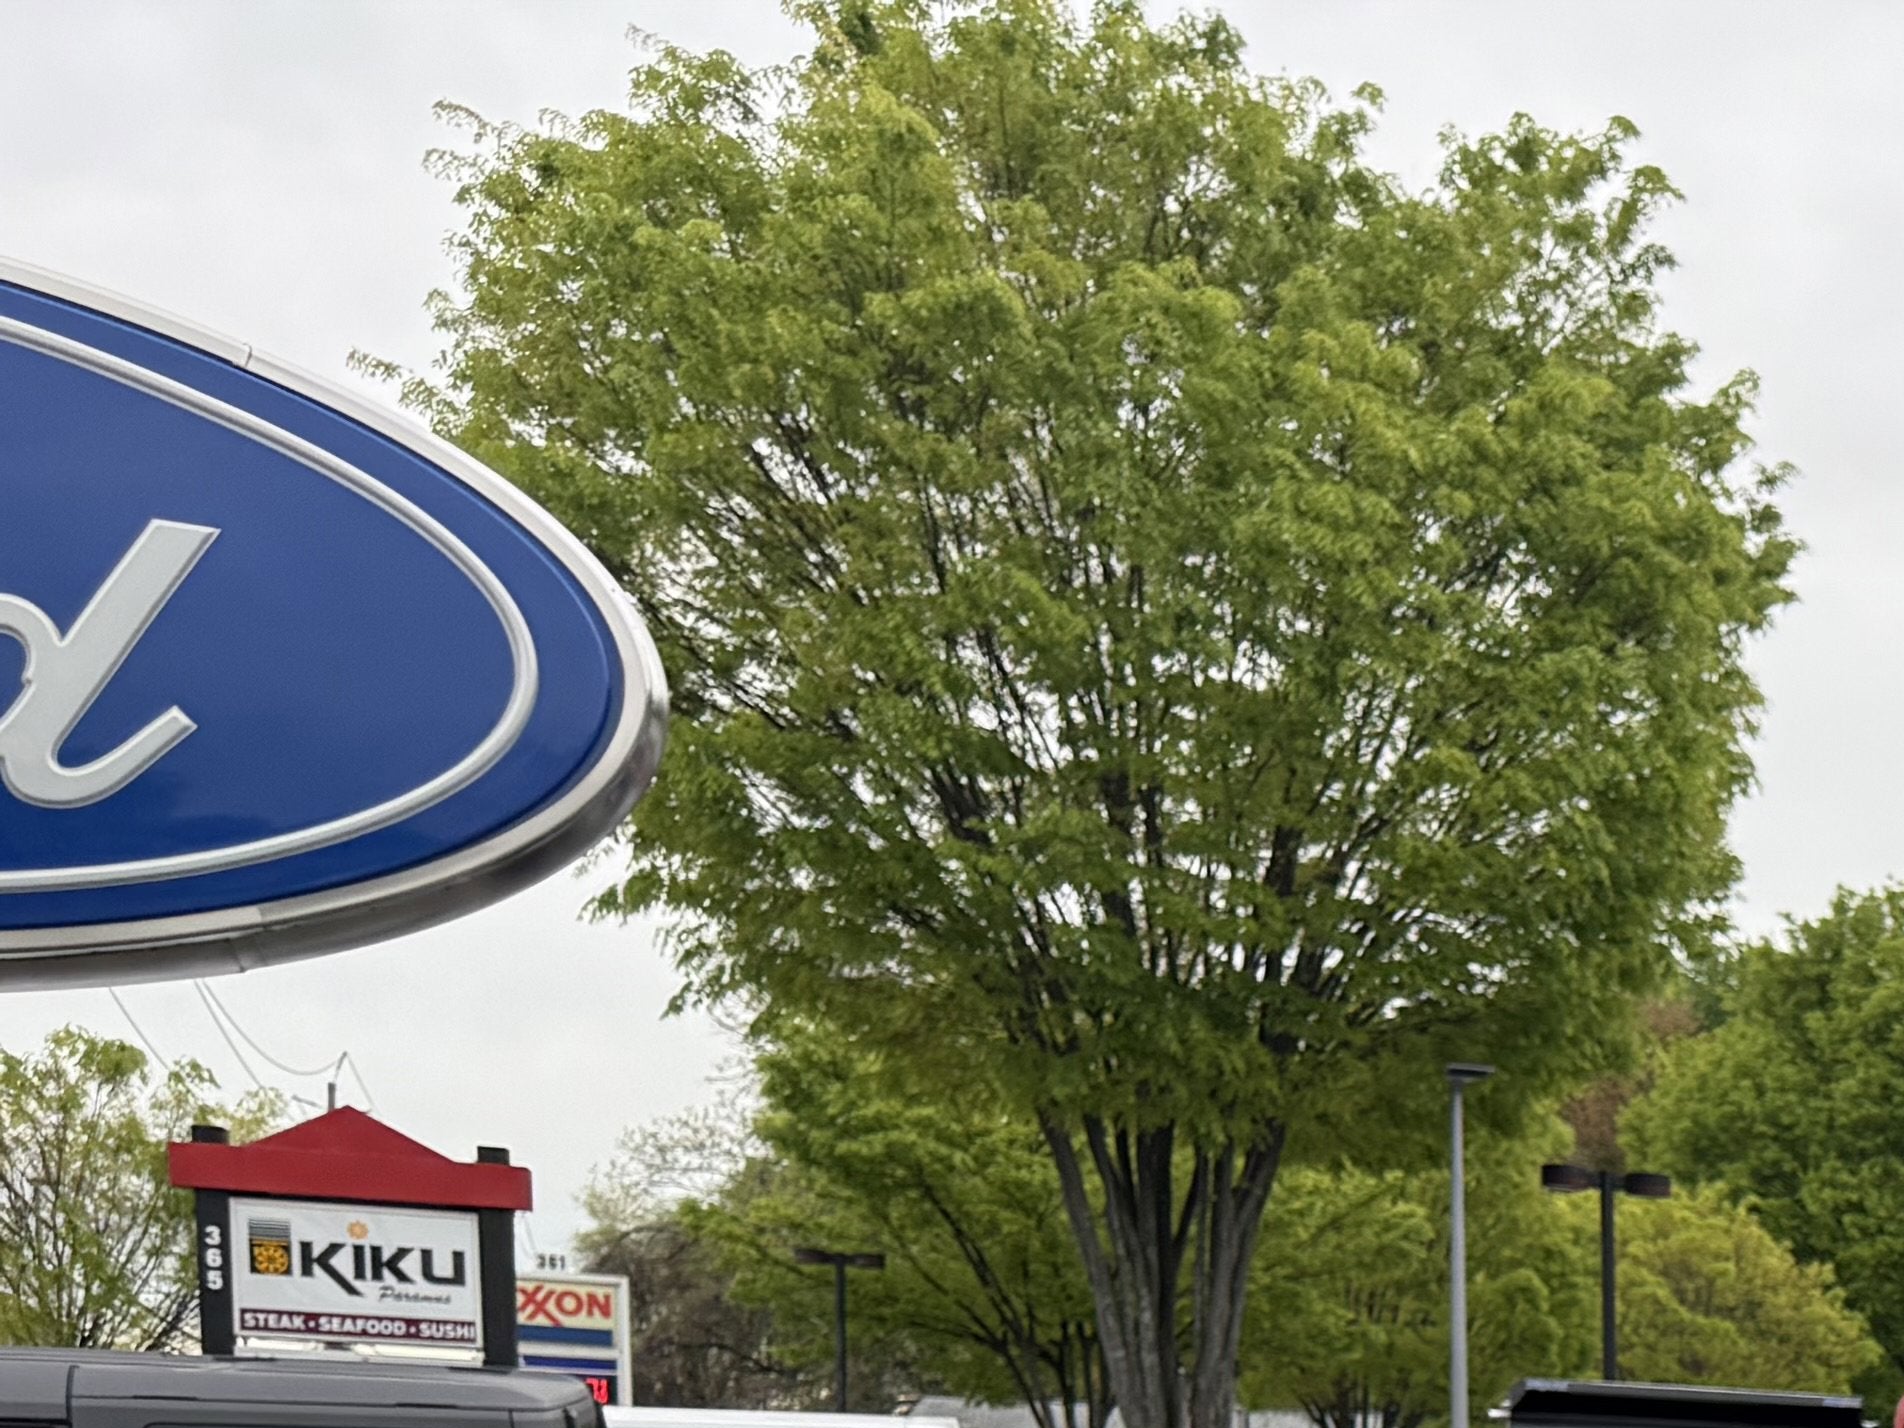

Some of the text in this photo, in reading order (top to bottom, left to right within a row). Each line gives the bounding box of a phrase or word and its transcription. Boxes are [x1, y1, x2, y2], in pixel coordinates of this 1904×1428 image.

[516, 1283, 612, 1327] XXON
[243, 1311, 476, 1340] STEAK SEAFOOD SUSHI
